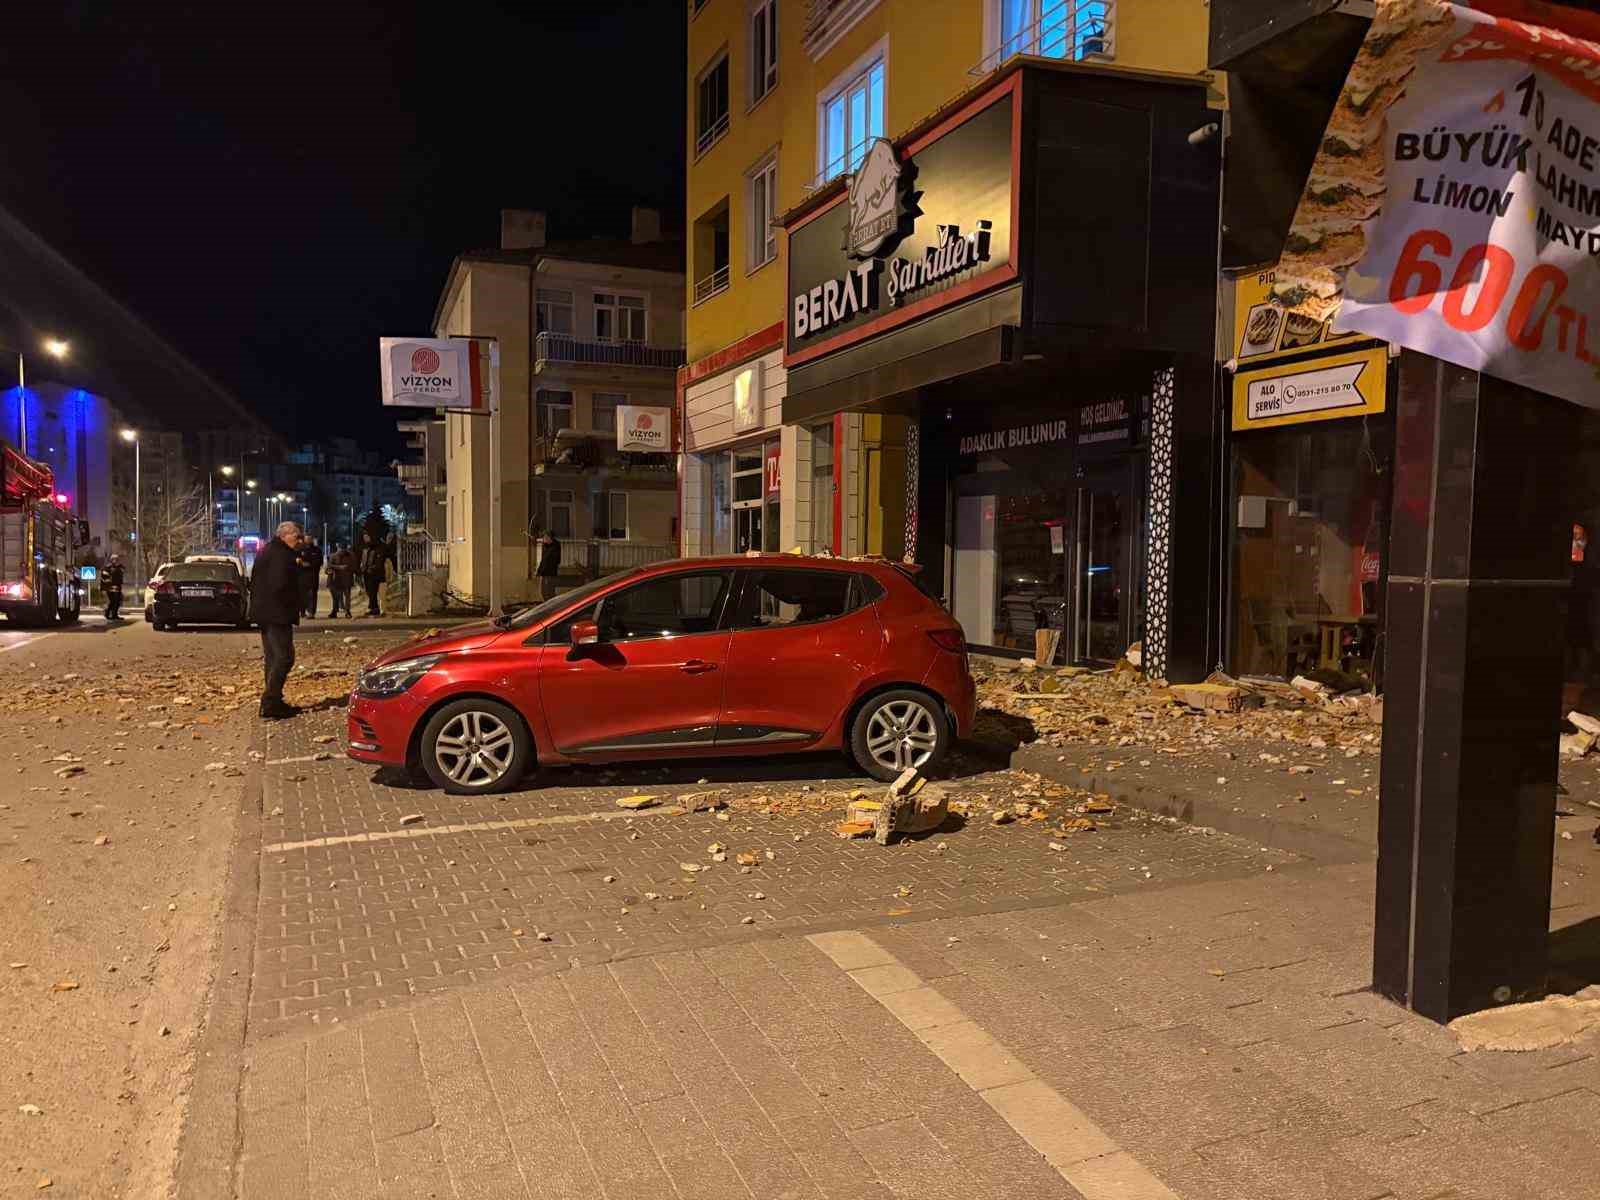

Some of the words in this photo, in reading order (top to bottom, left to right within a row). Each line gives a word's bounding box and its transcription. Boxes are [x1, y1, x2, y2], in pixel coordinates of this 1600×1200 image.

[1395, 125, 1532, 173] BÜYÜK
[1548, 117, 1600, 172] ADE
[1413, 174, 1515, 218] LİMON
[795, 260, 874, 338] BERAT
[887, 220, 991, 306] Şarküteri
[401, 374, 451, 387] VİZYON
[1261, 384, 1275, 396] ALO
[1255, 396, 1280, 412] SERVİS
[959, 431, 1006, 455] ADAKLIK
[1008, 420, 1067, 447] BULUNUR
